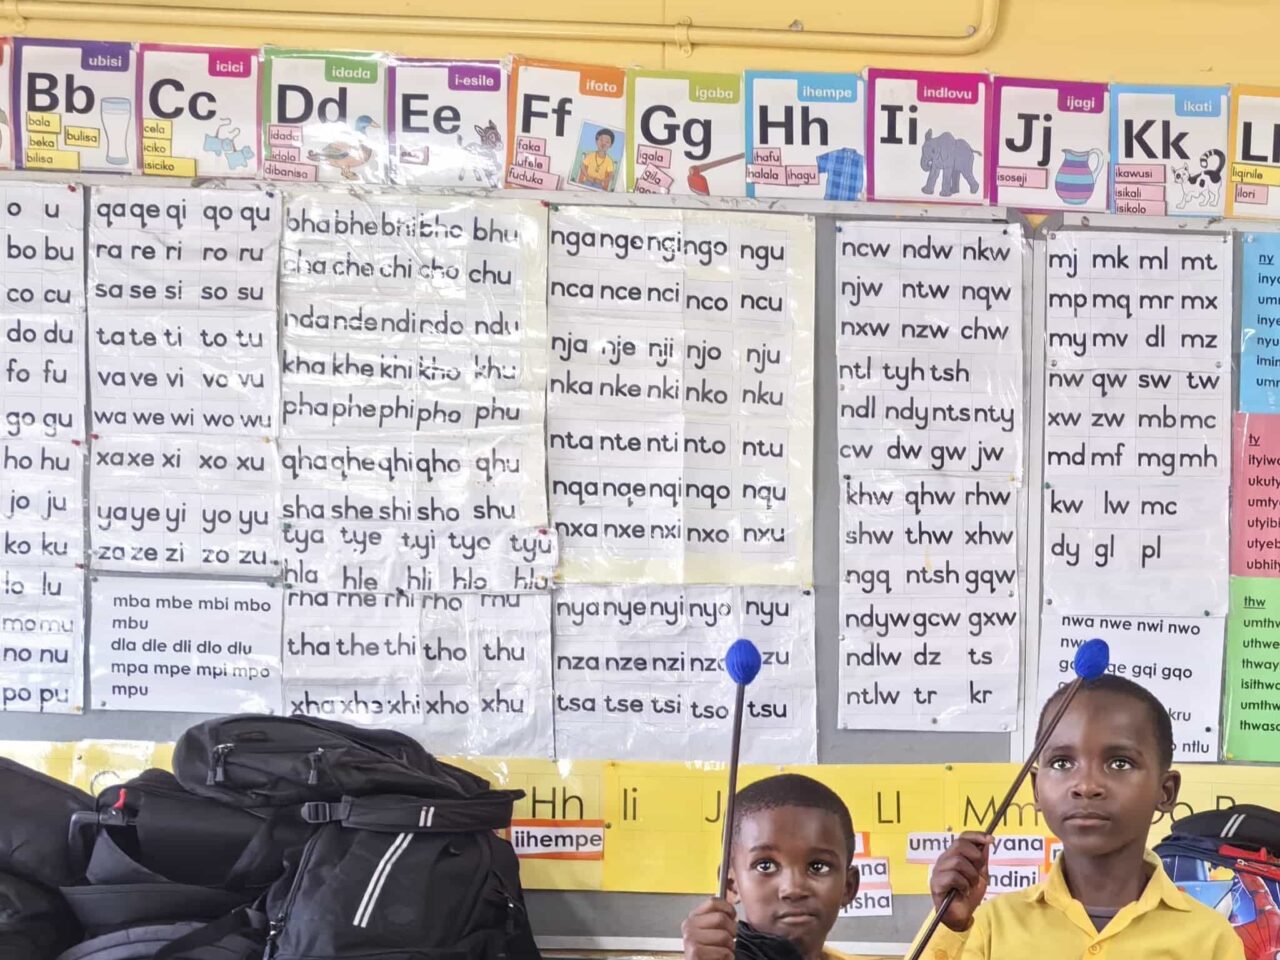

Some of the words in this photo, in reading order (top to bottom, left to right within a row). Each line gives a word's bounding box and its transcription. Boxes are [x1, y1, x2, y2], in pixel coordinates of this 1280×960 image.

[89, 56, 122, 67] ubisi
[216, 60, 244, 73] icici
[332, 65, 371, 79] idada
[454, 74, 495, 87] i-esile
[586, 80, 617, 92] ifoto
[27, 72, 95, 114] Bb
[149, 79, 217, 121] Cc
[696, 87, 734, 101] igaba
[803, 86, 852, 100] ihempe
[923, 87, 972, 100] indlovu
[277, 84, 348, 124] Dd
[1067, 96, 1095, 110] ijagi
[1183, 100, 1212, 112] ikati
[401, 93, 461, 135] Ee
[522, 93, 573, 137] Ff
[28, 116, 51, 127] bala
[759, 105, 829, 146] Hh
[880, 104, 918, 145] Ii
[640, 104, 712, 161] Gg
[1124, 119, 1191, 160] Kk
[29, 137, 55, 148] beka
[518, 139, 541, 152] faka
[1005, 113, 1053, 167] Jj
[26, 152, 54, 164] bilisa
[640, 152, 664, 165] igala
[508, 169, 544, 186] fuduka
[787, 170, 816, 184] ihagu
[1115, 169, 1153, 179] ikawusi
[1115, 189, 1142, 199] isikali
[1117, 205, 1147, 215] isikolo
[842, 241, 890, 257] ncw
[902, 234, 953, 259] ndw
[963, 236, 1011, 261] nkw
[1049, 248, 1077, 278] mj
[1092, 244, 1129, 269] mk
[1139, 246, 1168, 270] ml
[1181, 254, 1218, 270] mt
[1259, 254, 1274, 265] ny
[551, 281, 593, 298] nca
[600, 283, 642, 300] nce
[647, 282, 680, 302] nci
[686, 293, 728, 311] nco
[741, 293, 782, 312] ncu
[113, 595, 150, 608] mba
[156, 596, 193, 609] mbe
[198, 596, 229, 610] mbi
[234, 598, 271, 612] mbo
[846, 643, 902, 666] ndlw
[913, 642, 941, 665] dz
[968, 648, 993, 664] ts
[531, 787, 585, 820] Hh
[514, 831, 603, 855] iihempe
